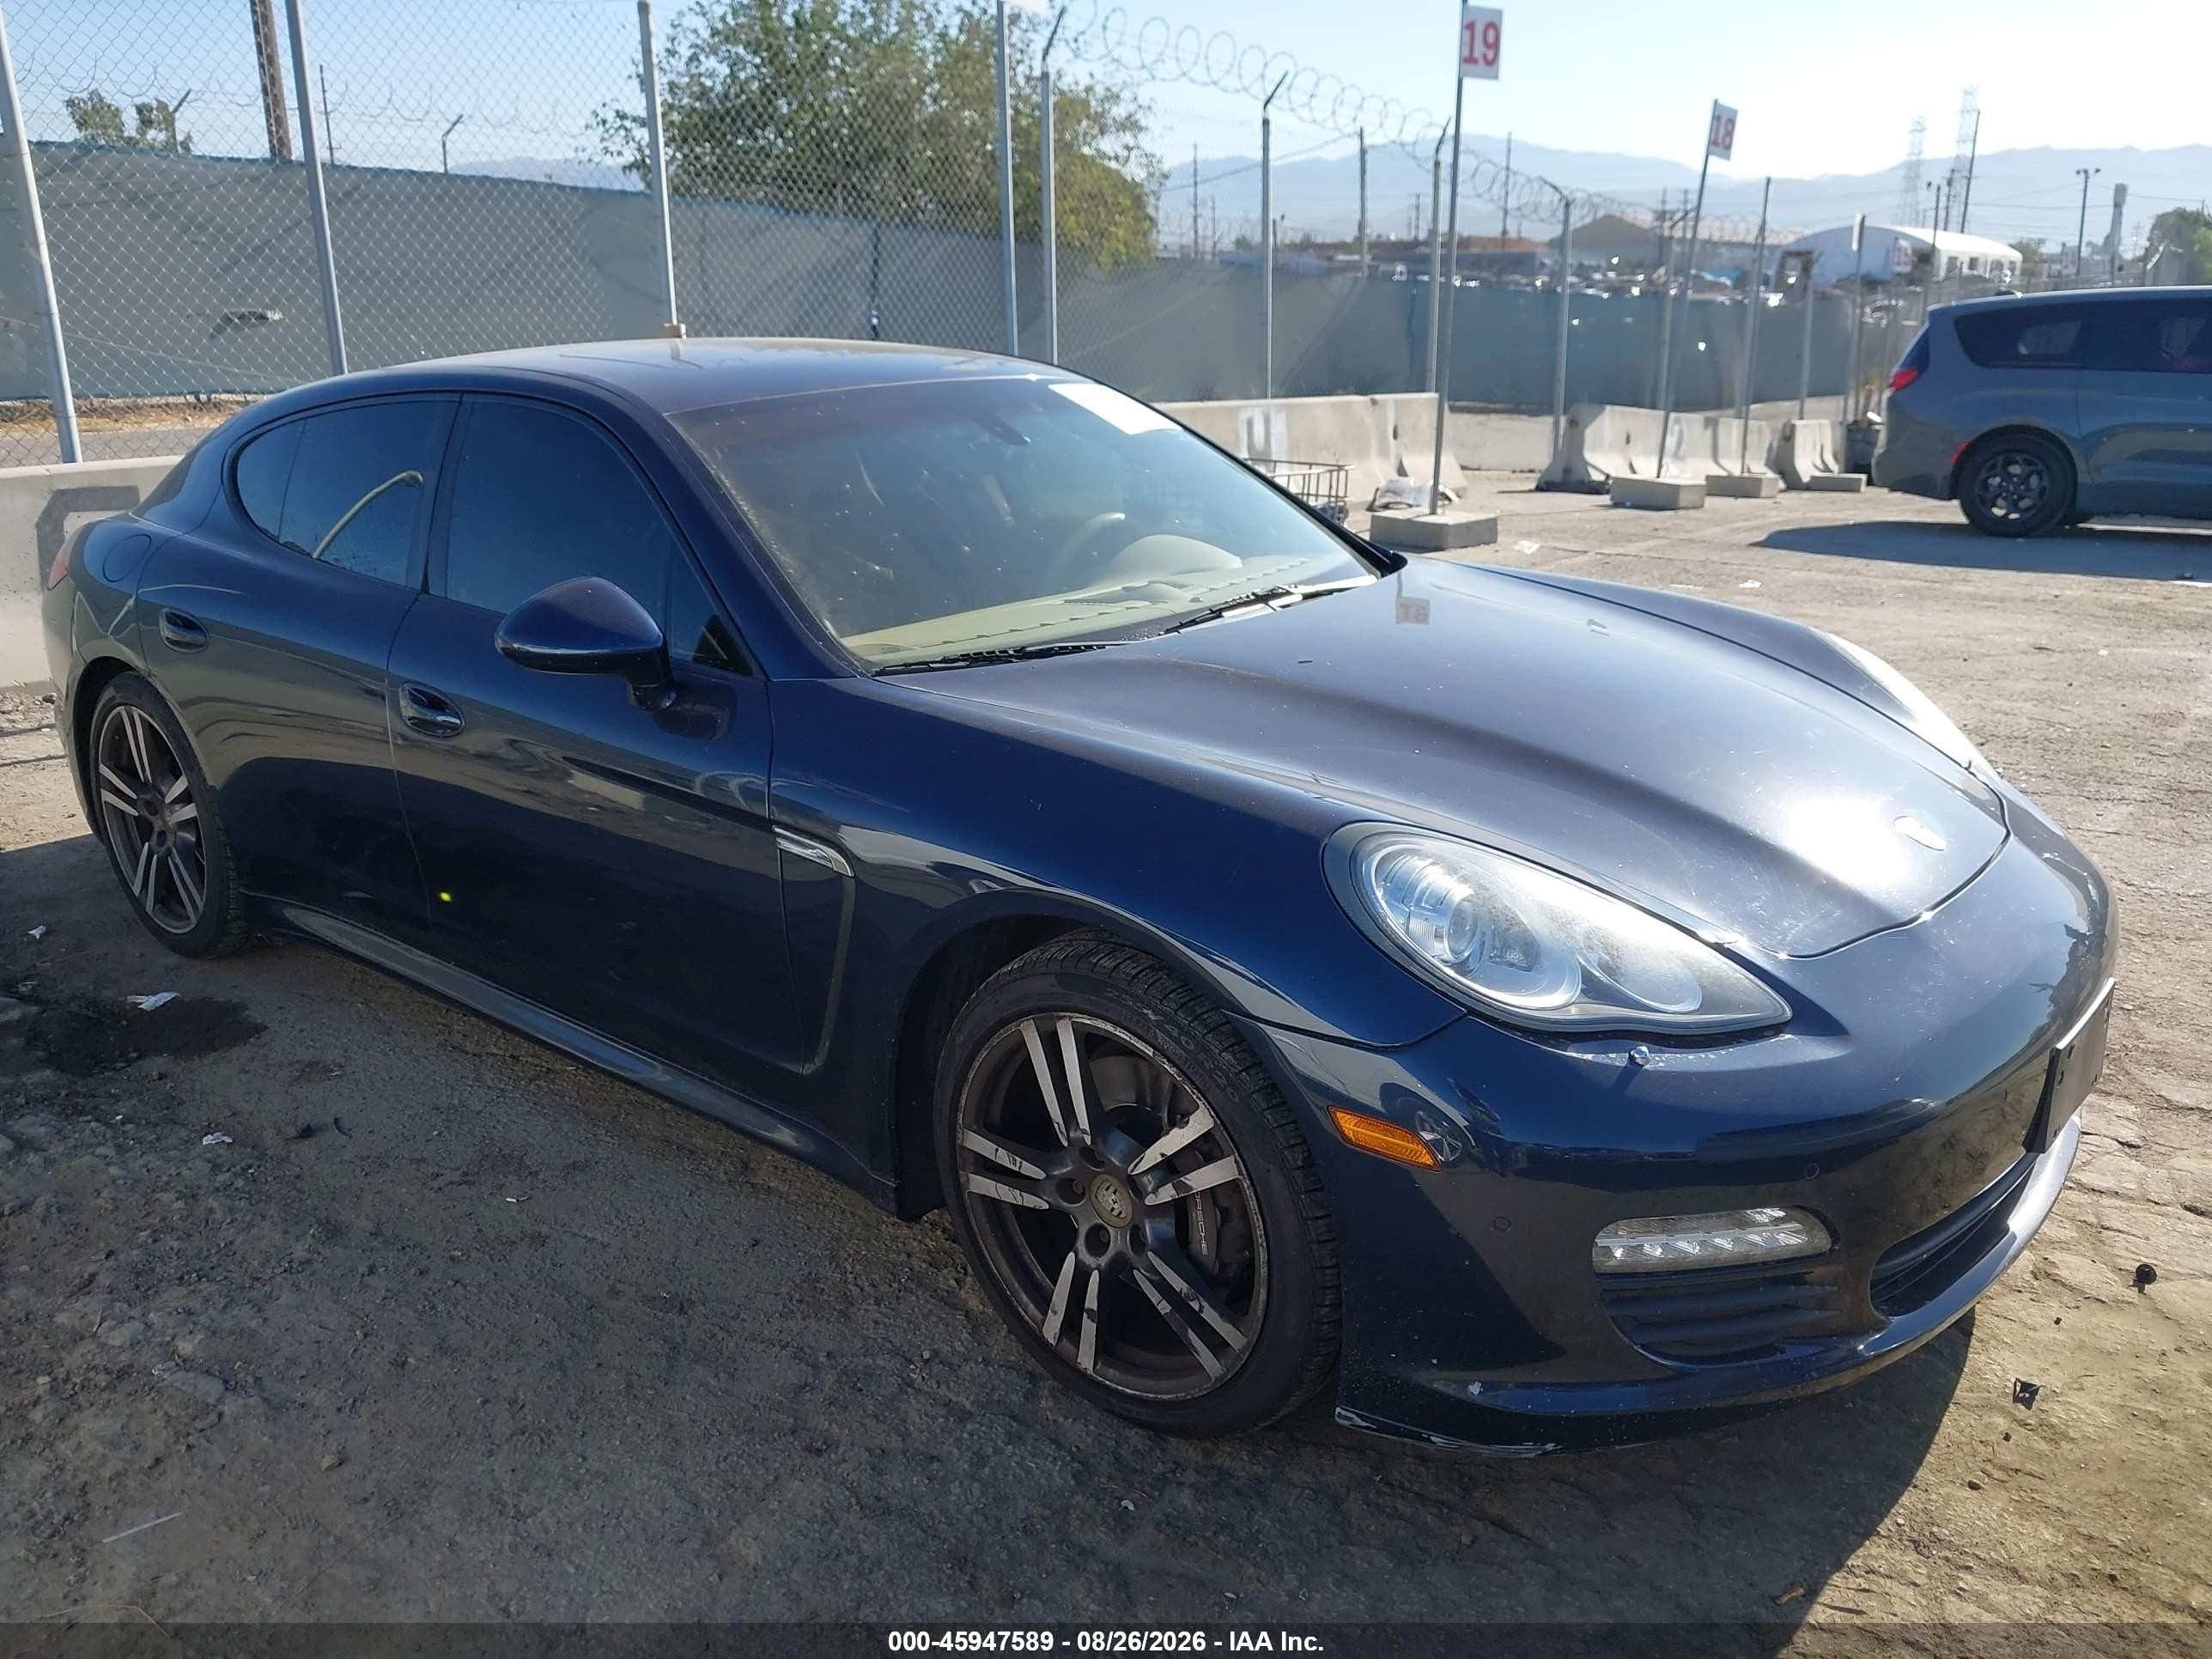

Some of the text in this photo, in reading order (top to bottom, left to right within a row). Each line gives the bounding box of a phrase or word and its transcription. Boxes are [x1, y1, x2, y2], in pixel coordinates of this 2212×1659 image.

[1462, 20, 1499, 68] 19
[1711, 115, 1734, 150] 18
[1194, 1191, 1209, 1255] ORSCHE
